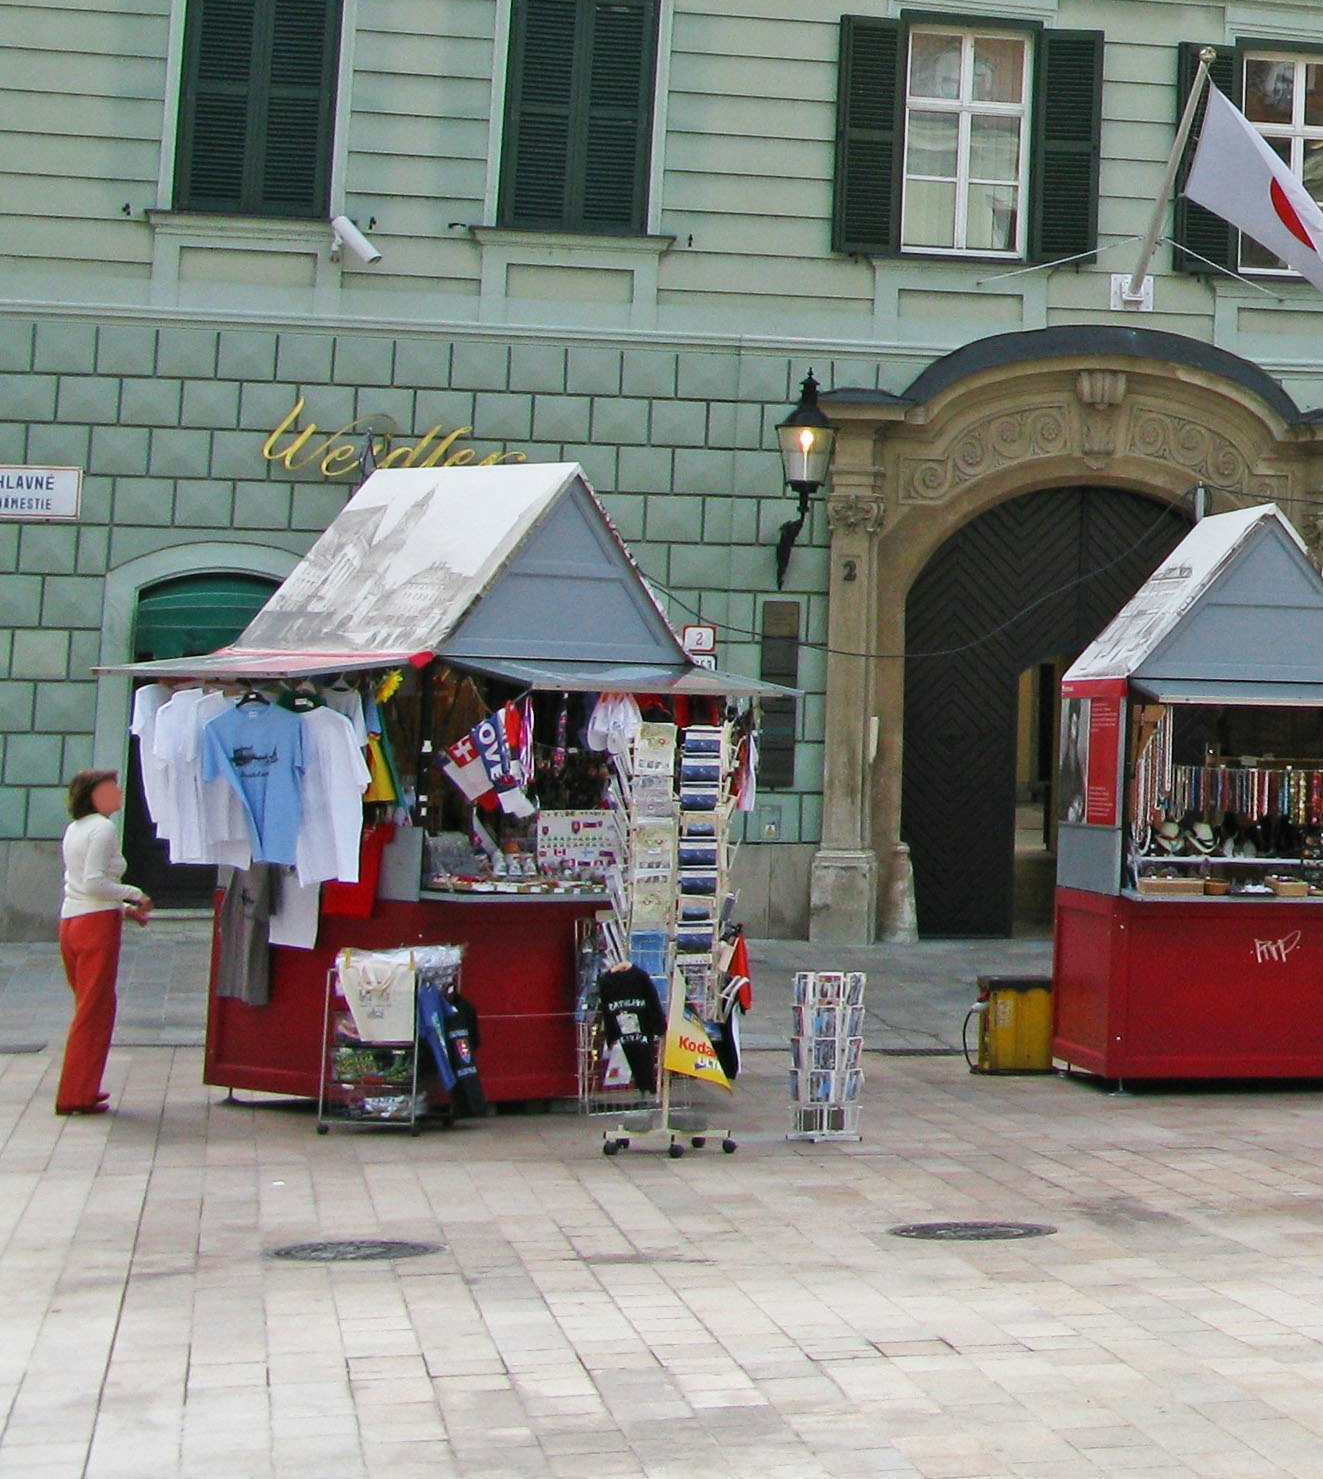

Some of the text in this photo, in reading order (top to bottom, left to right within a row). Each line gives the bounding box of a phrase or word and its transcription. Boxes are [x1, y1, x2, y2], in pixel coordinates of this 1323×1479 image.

[842, 560, 857, 582] 2
[695, 632, 704, 646] 2
[679, 1035, 717, 1057] Koda
